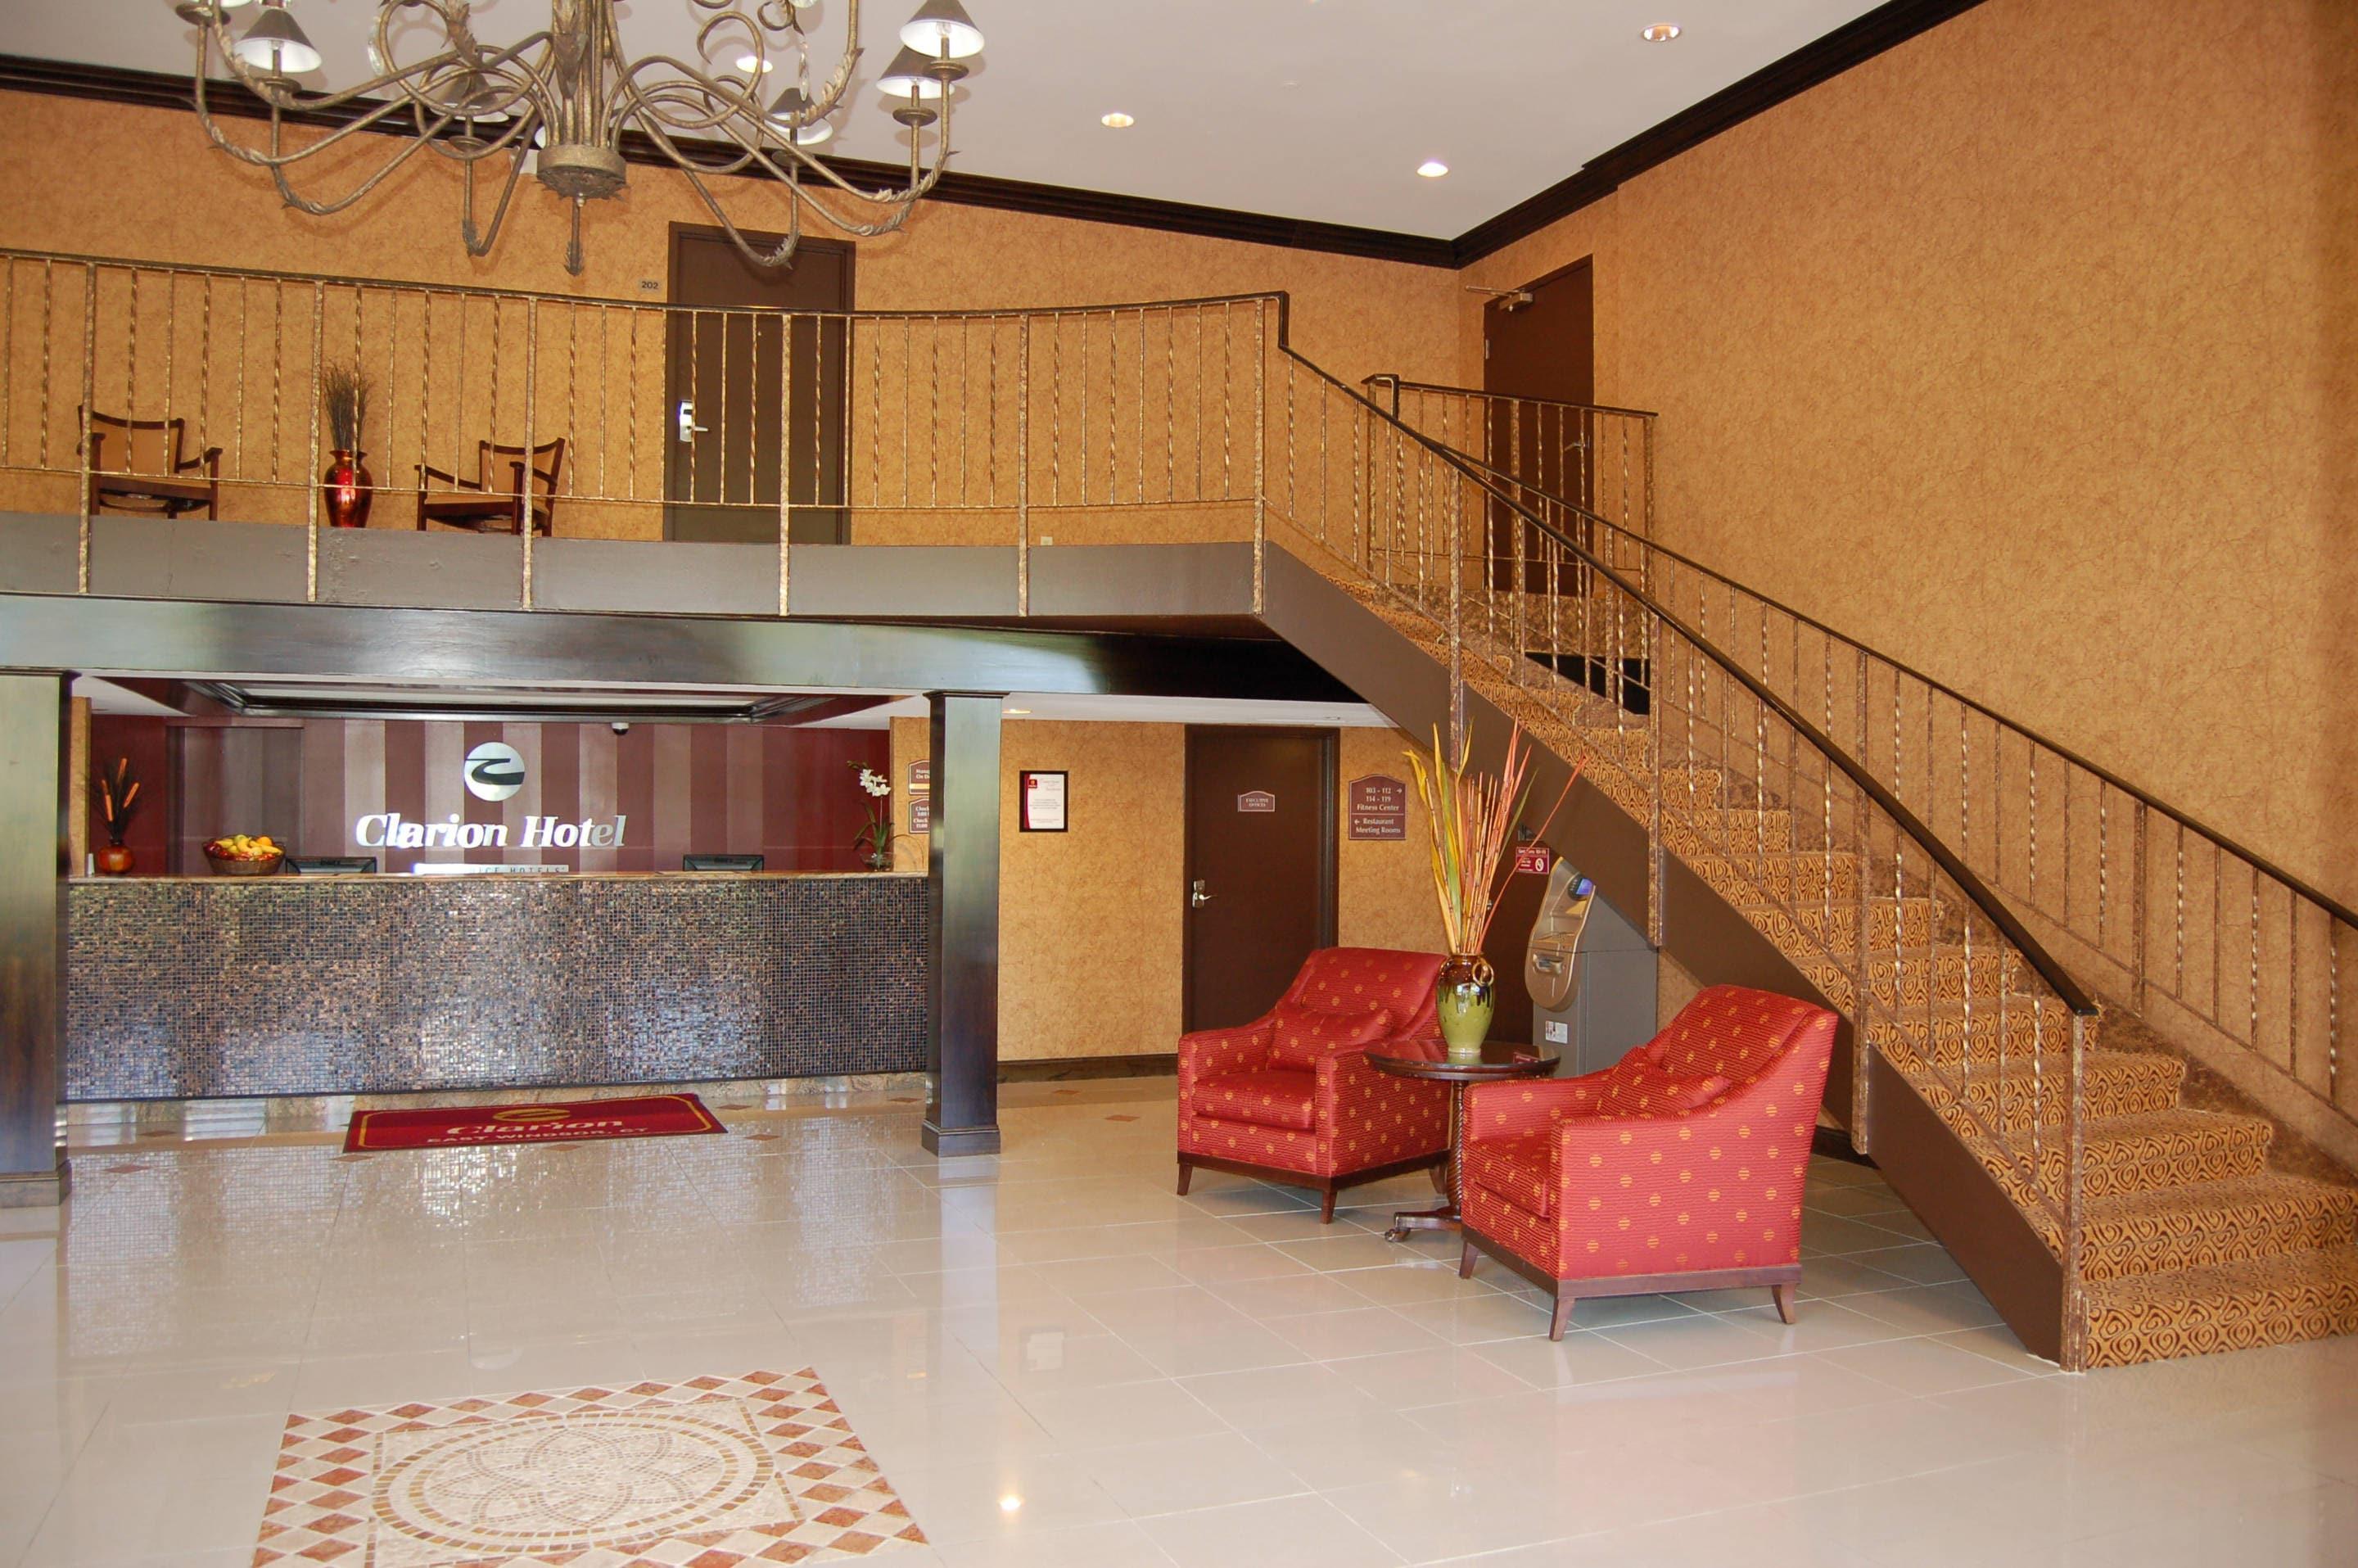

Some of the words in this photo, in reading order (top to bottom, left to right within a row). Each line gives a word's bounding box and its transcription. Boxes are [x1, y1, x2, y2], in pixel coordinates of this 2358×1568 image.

[641, 281, 659, 290] 202
[1379, 803, 1399, 811] Center
[355, 812, 508, 849] Clarion
[519, 814, 627, 848] Hotel
[1356, 826, 1380, 835] Meeting
[446, 1120, 623, 1134] Clarion
[427, 1135, 489, 1143] EAST
